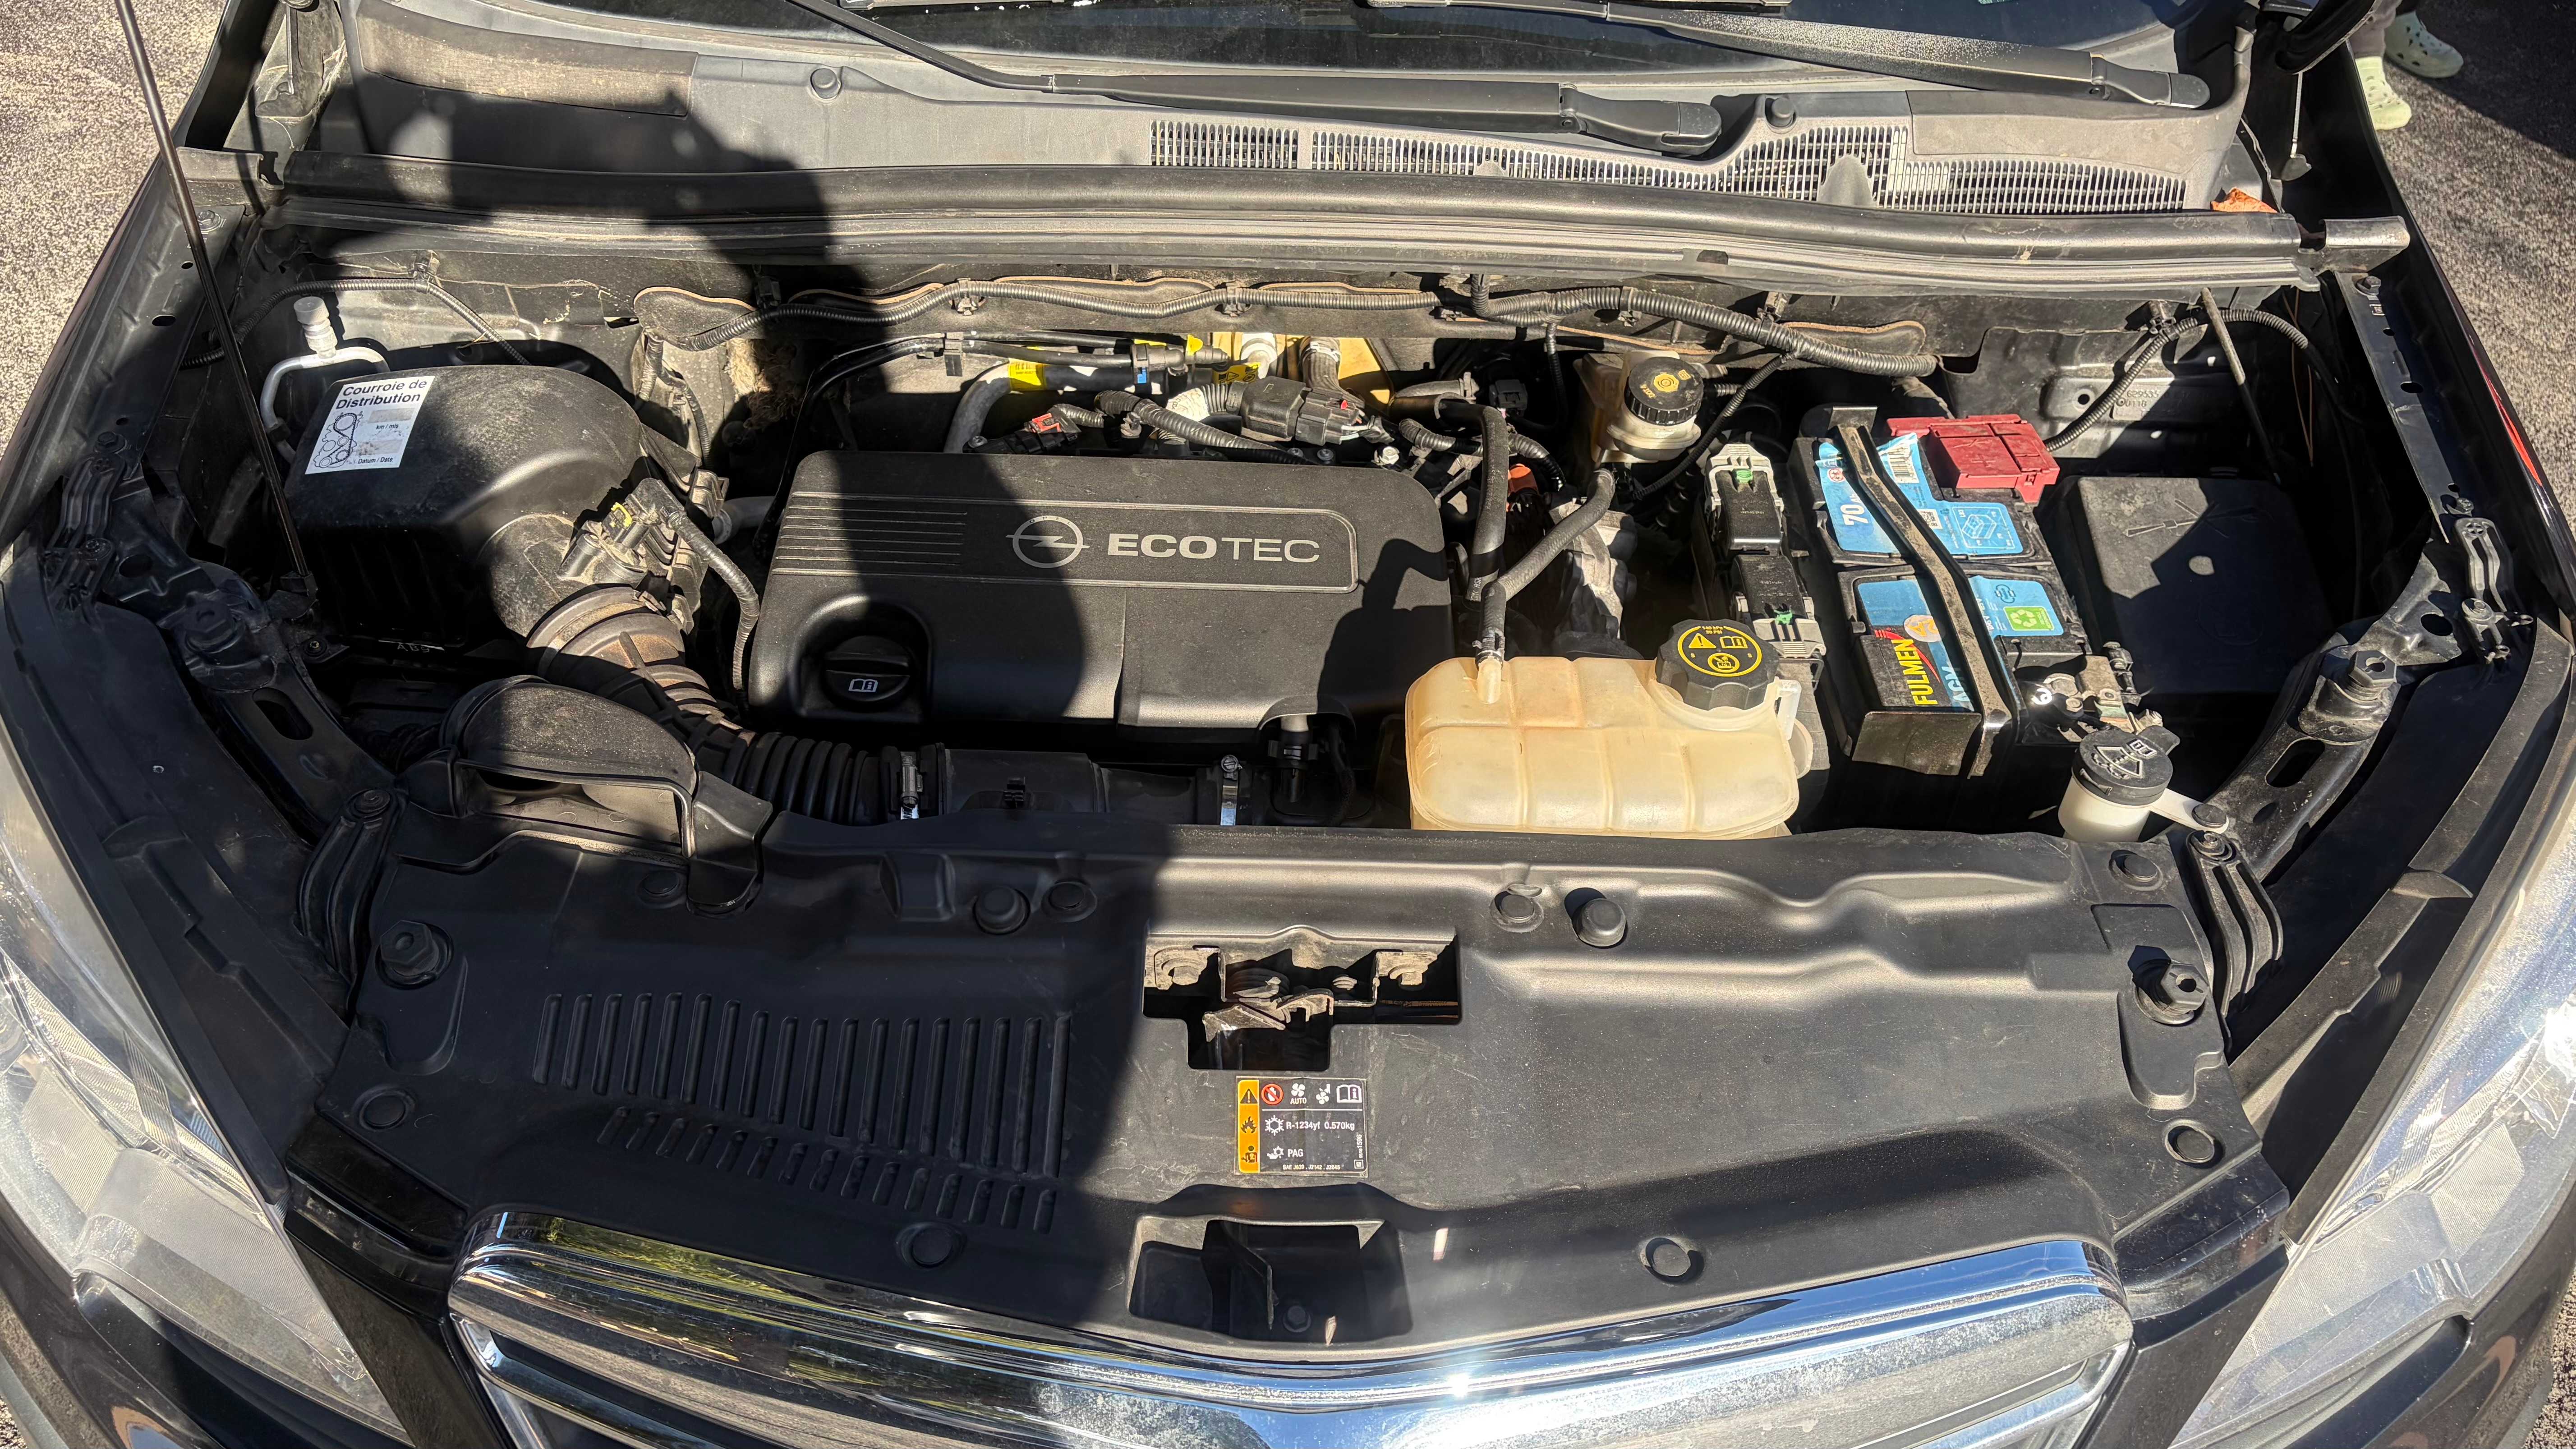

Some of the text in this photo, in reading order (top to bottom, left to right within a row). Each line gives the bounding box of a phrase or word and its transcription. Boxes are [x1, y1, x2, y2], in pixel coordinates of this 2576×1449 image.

[343, 379, 427, 396] Courroie de
[336, 393, 421, 409] Distribution
[1029, 516, 1071, 526] OPEL
[1840, 504, 1869, 526] 70
[1108, 534, 1320, 563] ECOTEC
[1891, 639, 1938, 705] FULMEN
[1286, 1121, 1355, 1131] R-1234yf 0.570kg
[1288, 1149, 1304, 1158] PAG
